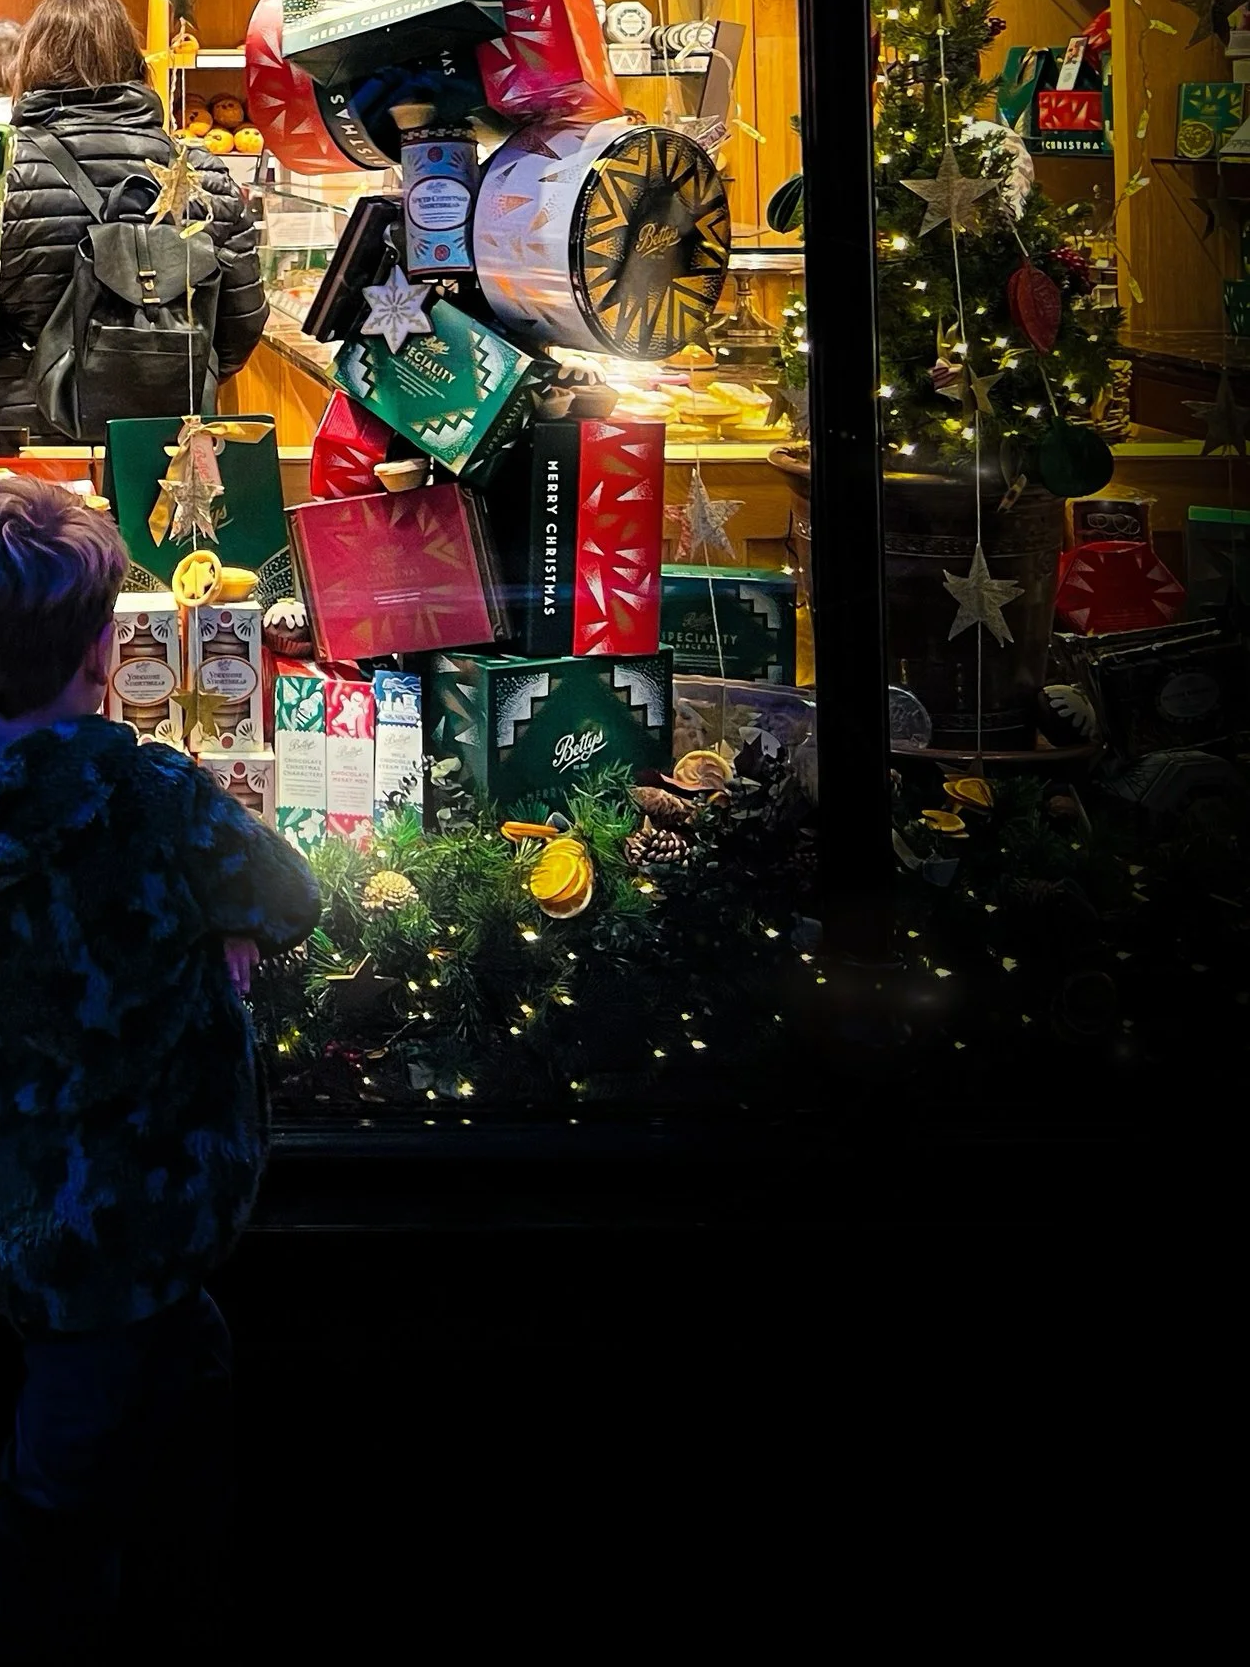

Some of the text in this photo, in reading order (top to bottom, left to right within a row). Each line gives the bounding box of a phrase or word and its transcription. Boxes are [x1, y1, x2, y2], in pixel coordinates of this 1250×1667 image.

[309, 21, 356, 43] MERRY
[635, 222, 682, 258] Bettys
[406, 344, 457, 384] ECIALITY
[543, 460, 559, 616] MERRY CHRISTMAS
[660, 630, 739, 646] SPECIALTY
[551, 728, 610, 774] Bettys
